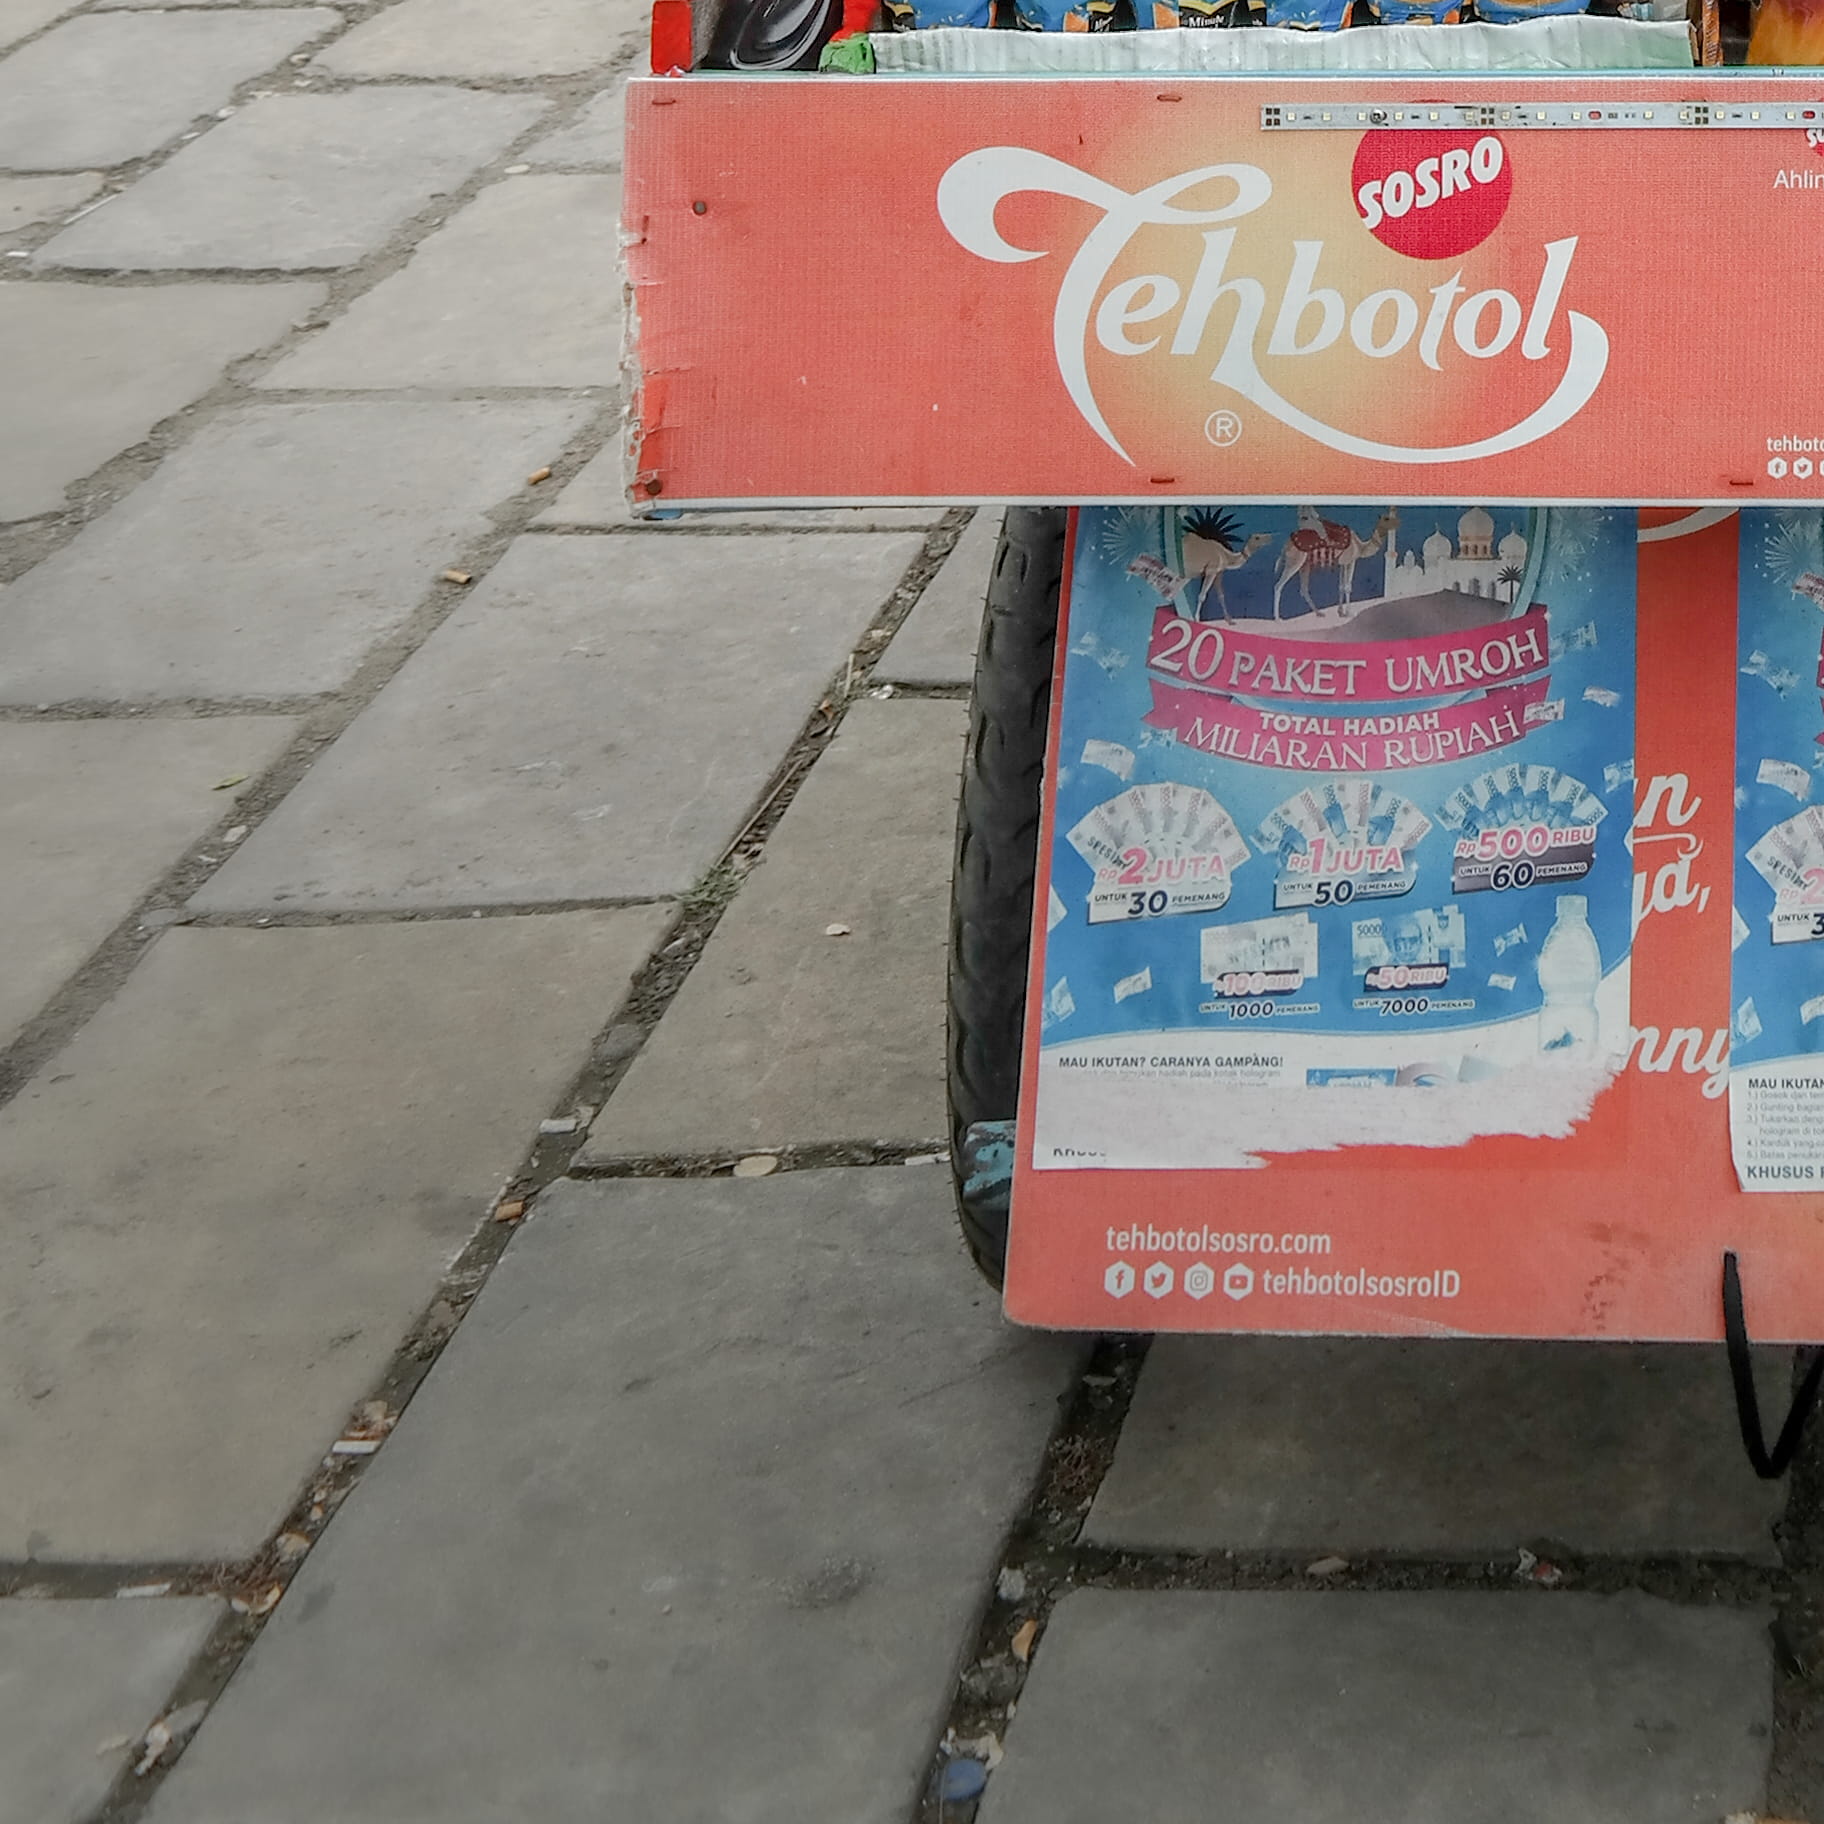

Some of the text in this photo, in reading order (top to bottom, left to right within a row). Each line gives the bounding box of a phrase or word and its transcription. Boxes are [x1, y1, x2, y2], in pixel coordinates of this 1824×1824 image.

[1357, 136, 1503, 230] SOSRO
[937, 146, 1610, 466] Tehbotol
[1150, 618, 1544, 696] 20 PAKET UMROH
[1260, 712, 1440, 736] TOTAL HADIAH
[1184, 708, 1520, 771] MILIARAN RUPIAH
[1552, 827, 1596, 845] RIBU
[1148, 854, 1226, 884] JUTA
[1325, 845, 1404, 874] JUTA
[1459, 861, 1587, 890] UNTUK 60 PEMENANG
[1095, 890, 1226, 916] UNTUK 30 PEMENANG
[1283, 879, 1407, 906] UNTUK 50 PEMENANG
[1777, 913, 1810, 923] UNTUK
[1410, 968, 1446, 983] RIBU
[1229, 1001, 1274, 1018] 1000
[1380, 998, 1429, 1014] 7000
[1059, 1056, 1284, 1069] MAU IKUTAN? CARANYA GAMPANG!
[1748, 1078, 1777, 1089] MAU
[1747, 1166, 1814, 1179] KHUSUS
[1106, 1224, 1331, 1255] tehbotolsosro.com
[1263, 1267, 1460, 1299] tehbotolsosroID
